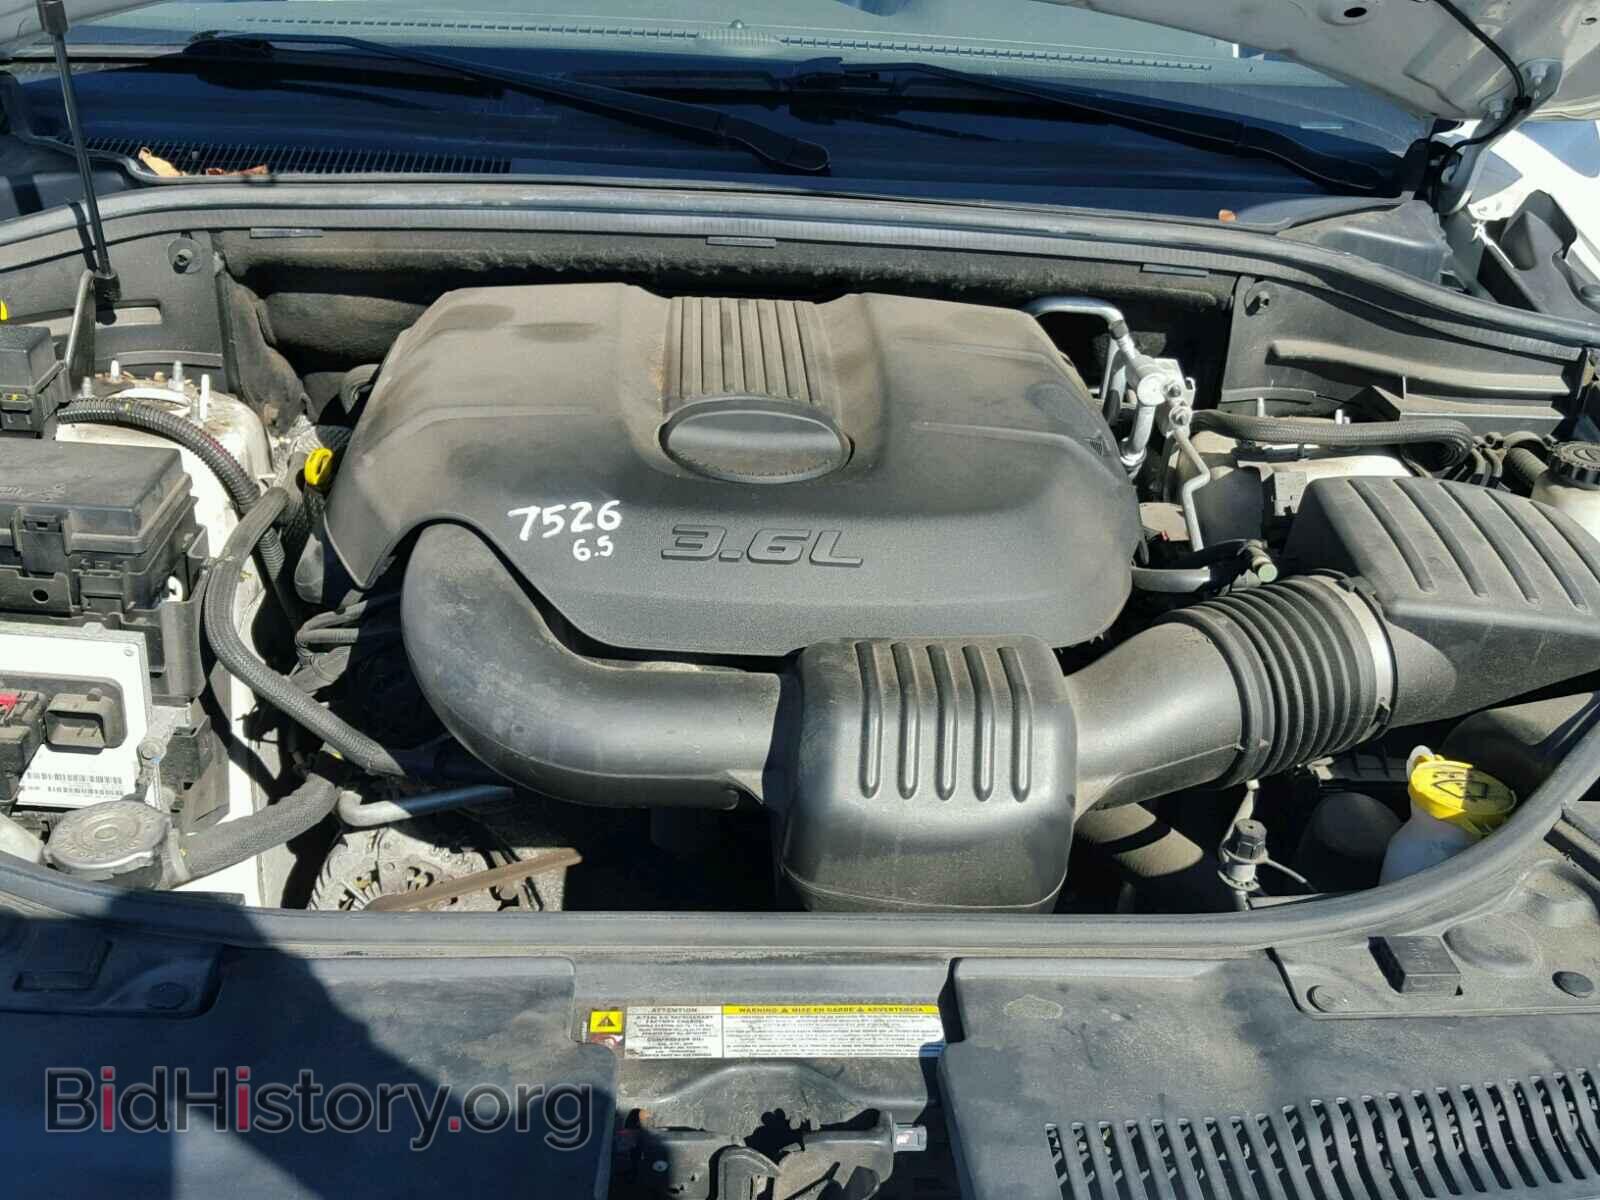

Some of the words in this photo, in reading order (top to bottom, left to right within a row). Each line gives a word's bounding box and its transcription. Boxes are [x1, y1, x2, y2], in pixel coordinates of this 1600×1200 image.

[507, 500, 623, 541] 7526
[572, 535, 614, 561] 6.5
[661, 524, 864, 567] 3.6L
